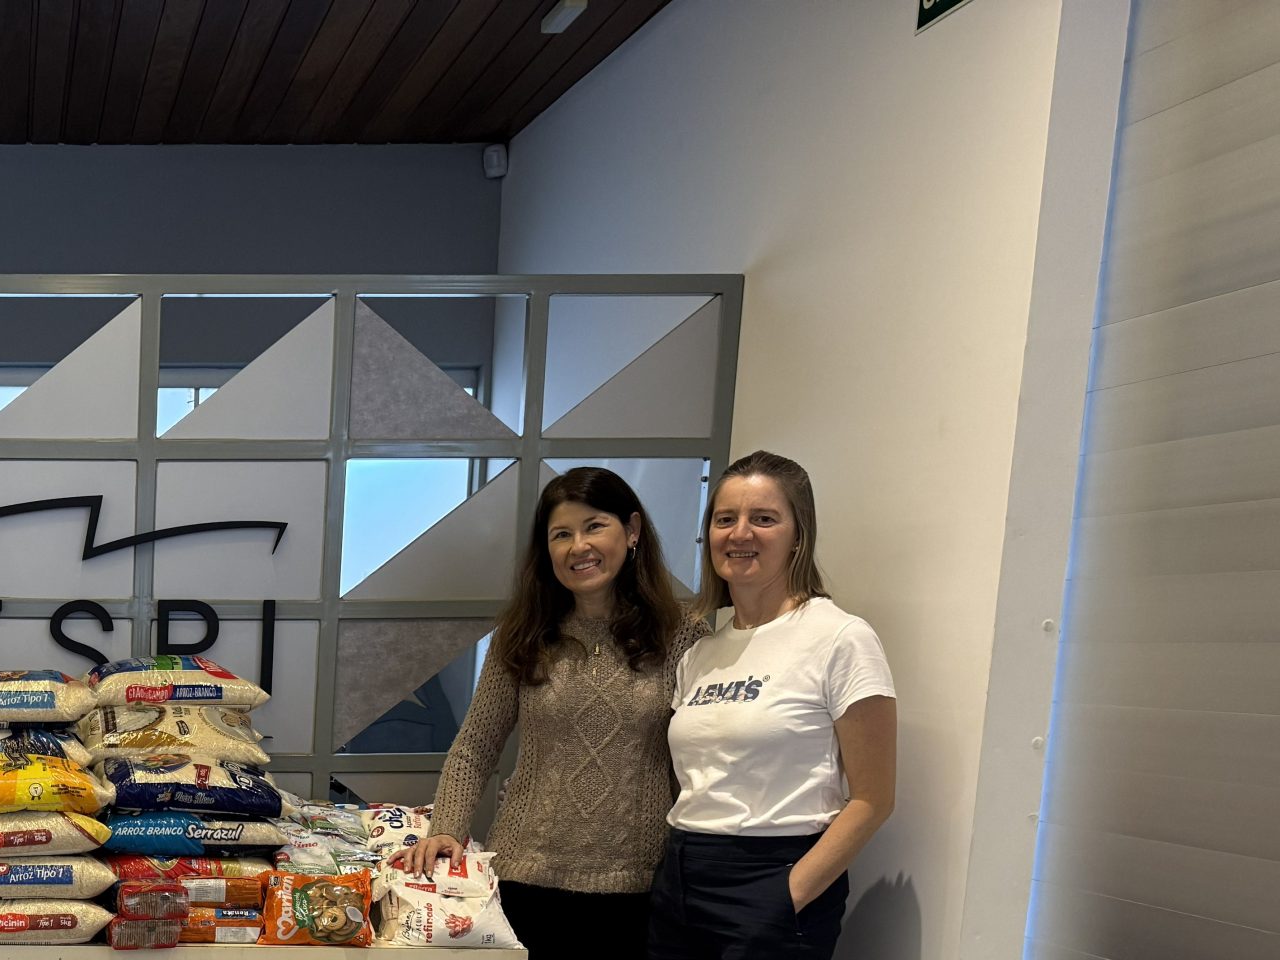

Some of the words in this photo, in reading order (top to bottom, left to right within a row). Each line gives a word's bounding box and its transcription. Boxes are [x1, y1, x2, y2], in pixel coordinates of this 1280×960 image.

[115, 827, 145, 836] ARROZ
[146, 826, 184, 836] BRANCO
[185, 824, 243, 841] Serrazul
[9, 872, 34, 884] Arroz
[36, 868, 56, 880] Tipo
[60, 918, 72, 927] 5kg
[423, 902, 433, 944] refinado
